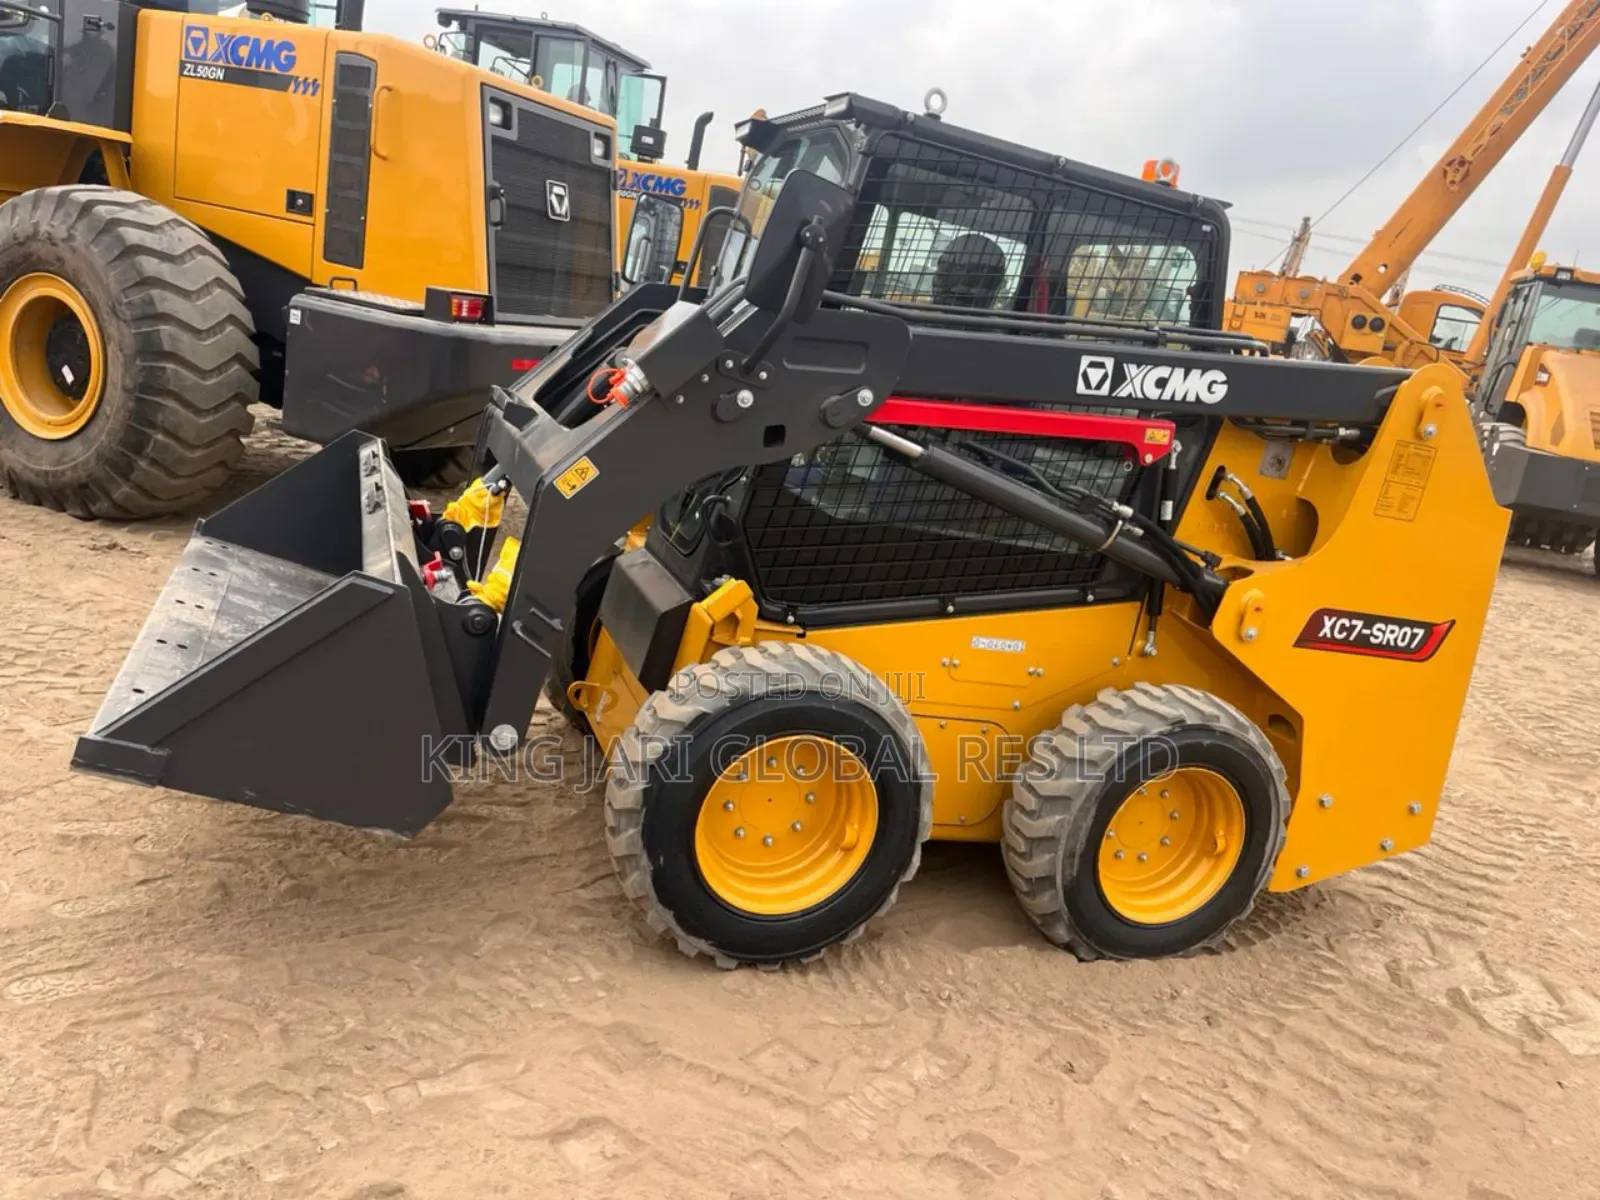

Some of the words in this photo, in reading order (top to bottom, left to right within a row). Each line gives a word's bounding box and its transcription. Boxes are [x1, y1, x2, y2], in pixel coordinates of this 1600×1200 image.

[208, 32, 297, 73] XCMG
[183, 63, 225, 80] ZL50GN
[628, 172, 687, 196] XCMG
[1112, 363, 1229, 405] XCMG
[1318, 614, 1425, 649] XC7-SR07
